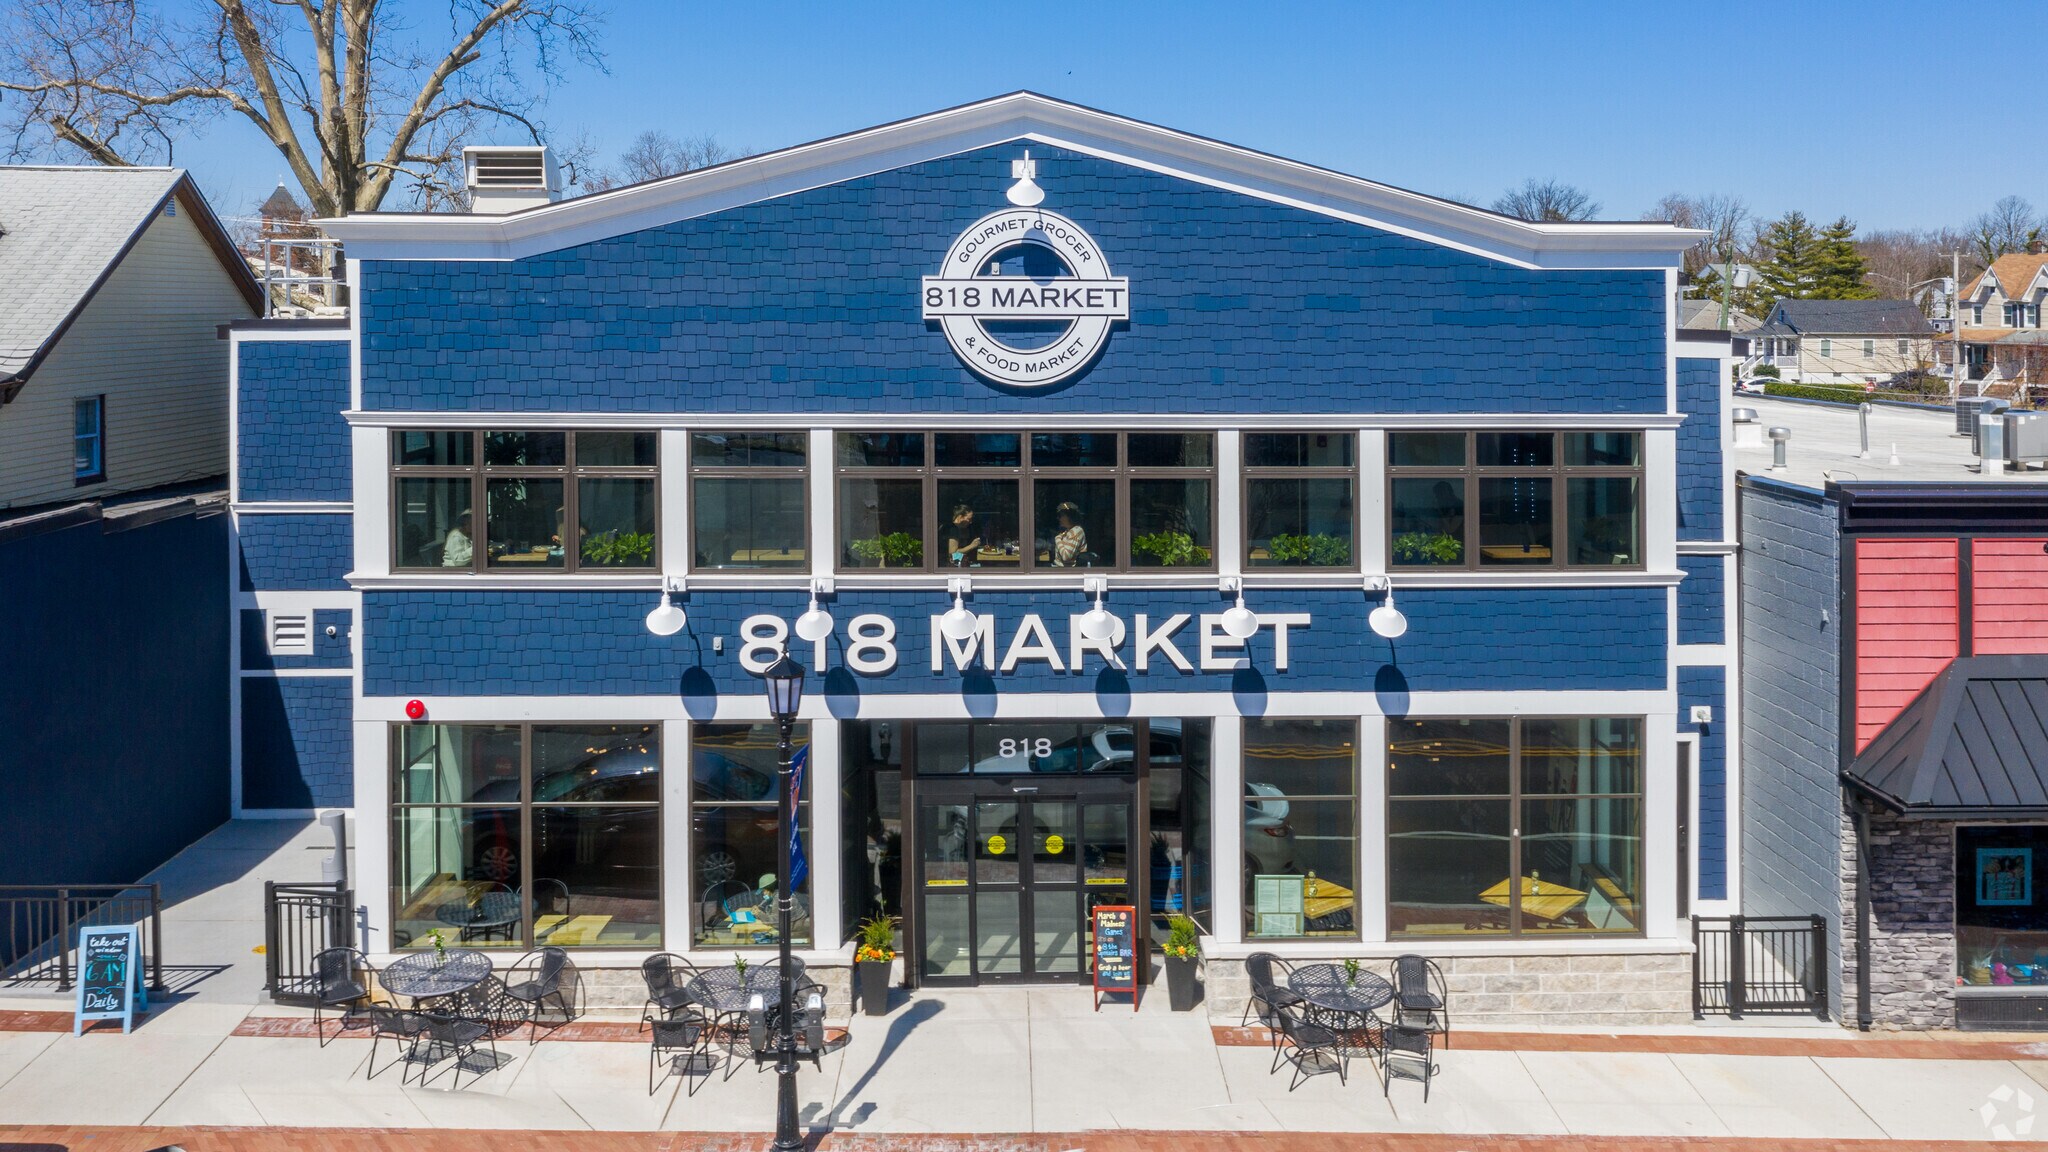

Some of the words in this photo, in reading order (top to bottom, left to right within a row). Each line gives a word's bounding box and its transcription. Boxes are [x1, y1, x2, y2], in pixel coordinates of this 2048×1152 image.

[958, 218, 1028, 263] GOURMET
[1033, 219, 1092, 263] GROCER
[926, 287, 981, 308] 818
[992, 287, 1126, 308] MARKET
[965, 336, 976, 349] &
[976, 348, 1020, 373] FOOD
[1025, 337, 1084, 373] MARKET
[739, 614, 897, 674] 818
[930, 613, 1311, 672] MARKET
[999, 738, 1052, 758] 818
[101, 962, 126, 982] AM
[85, 993, 118, 1011] Daily
